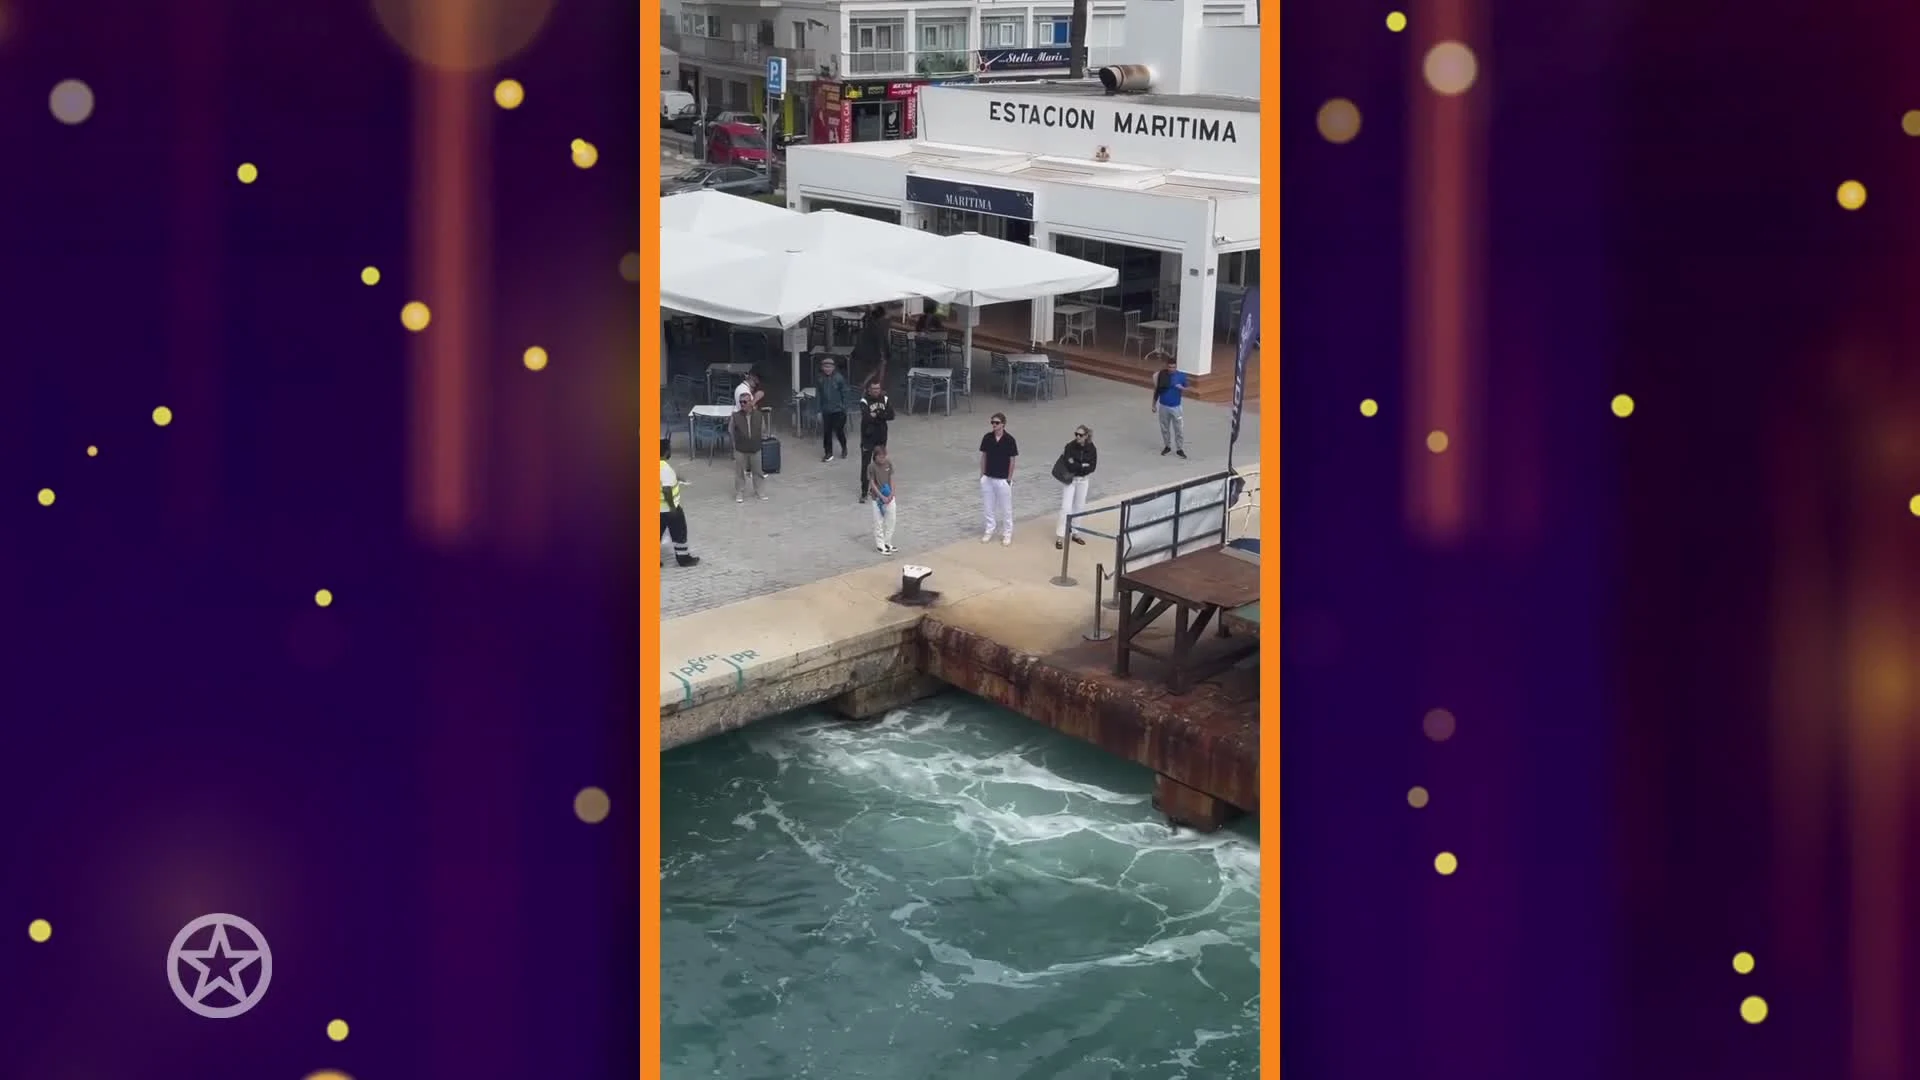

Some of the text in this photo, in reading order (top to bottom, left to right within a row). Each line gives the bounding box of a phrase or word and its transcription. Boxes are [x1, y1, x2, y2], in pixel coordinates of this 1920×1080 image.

[1006, 52, 1033, 63] Stella
[1035, 52, 1063, 62] Maris
[770, 61, 779, 81] P
[989, 101, 1237, 143] ESTACION MARITIMA
[945, 193, 992, 211] MARITIMA
